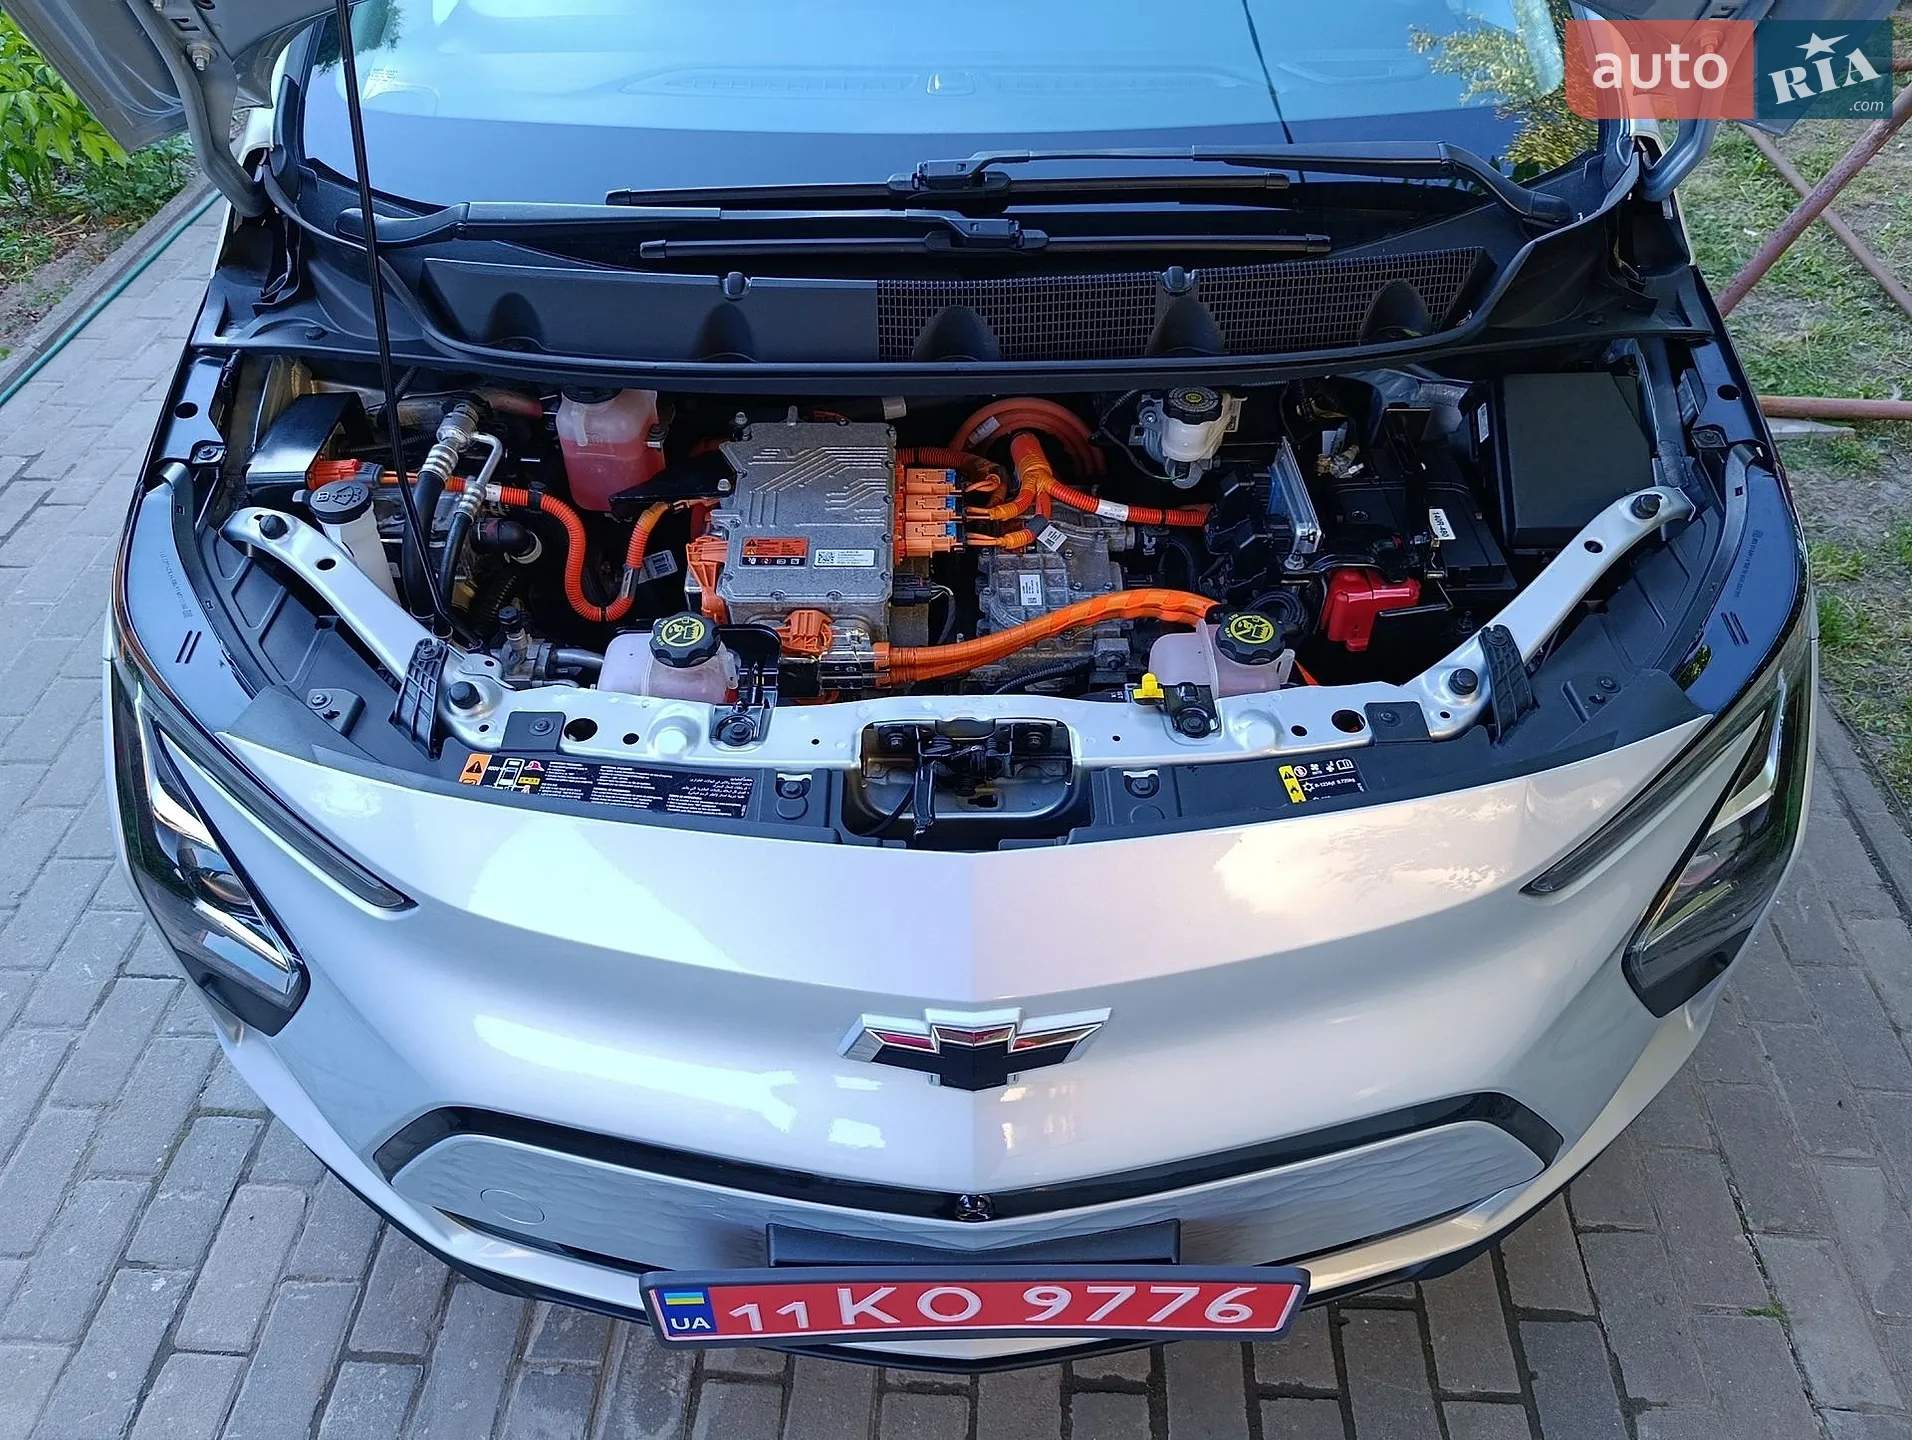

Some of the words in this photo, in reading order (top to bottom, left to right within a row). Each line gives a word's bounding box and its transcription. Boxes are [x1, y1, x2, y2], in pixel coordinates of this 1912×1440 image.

[670, 1315, 711, 1331] UA
[727, 1301, 809, 1332] 11
[836, 1286, 983, 1326] KO
[1022, 1285, 1257, 1323] 9776
